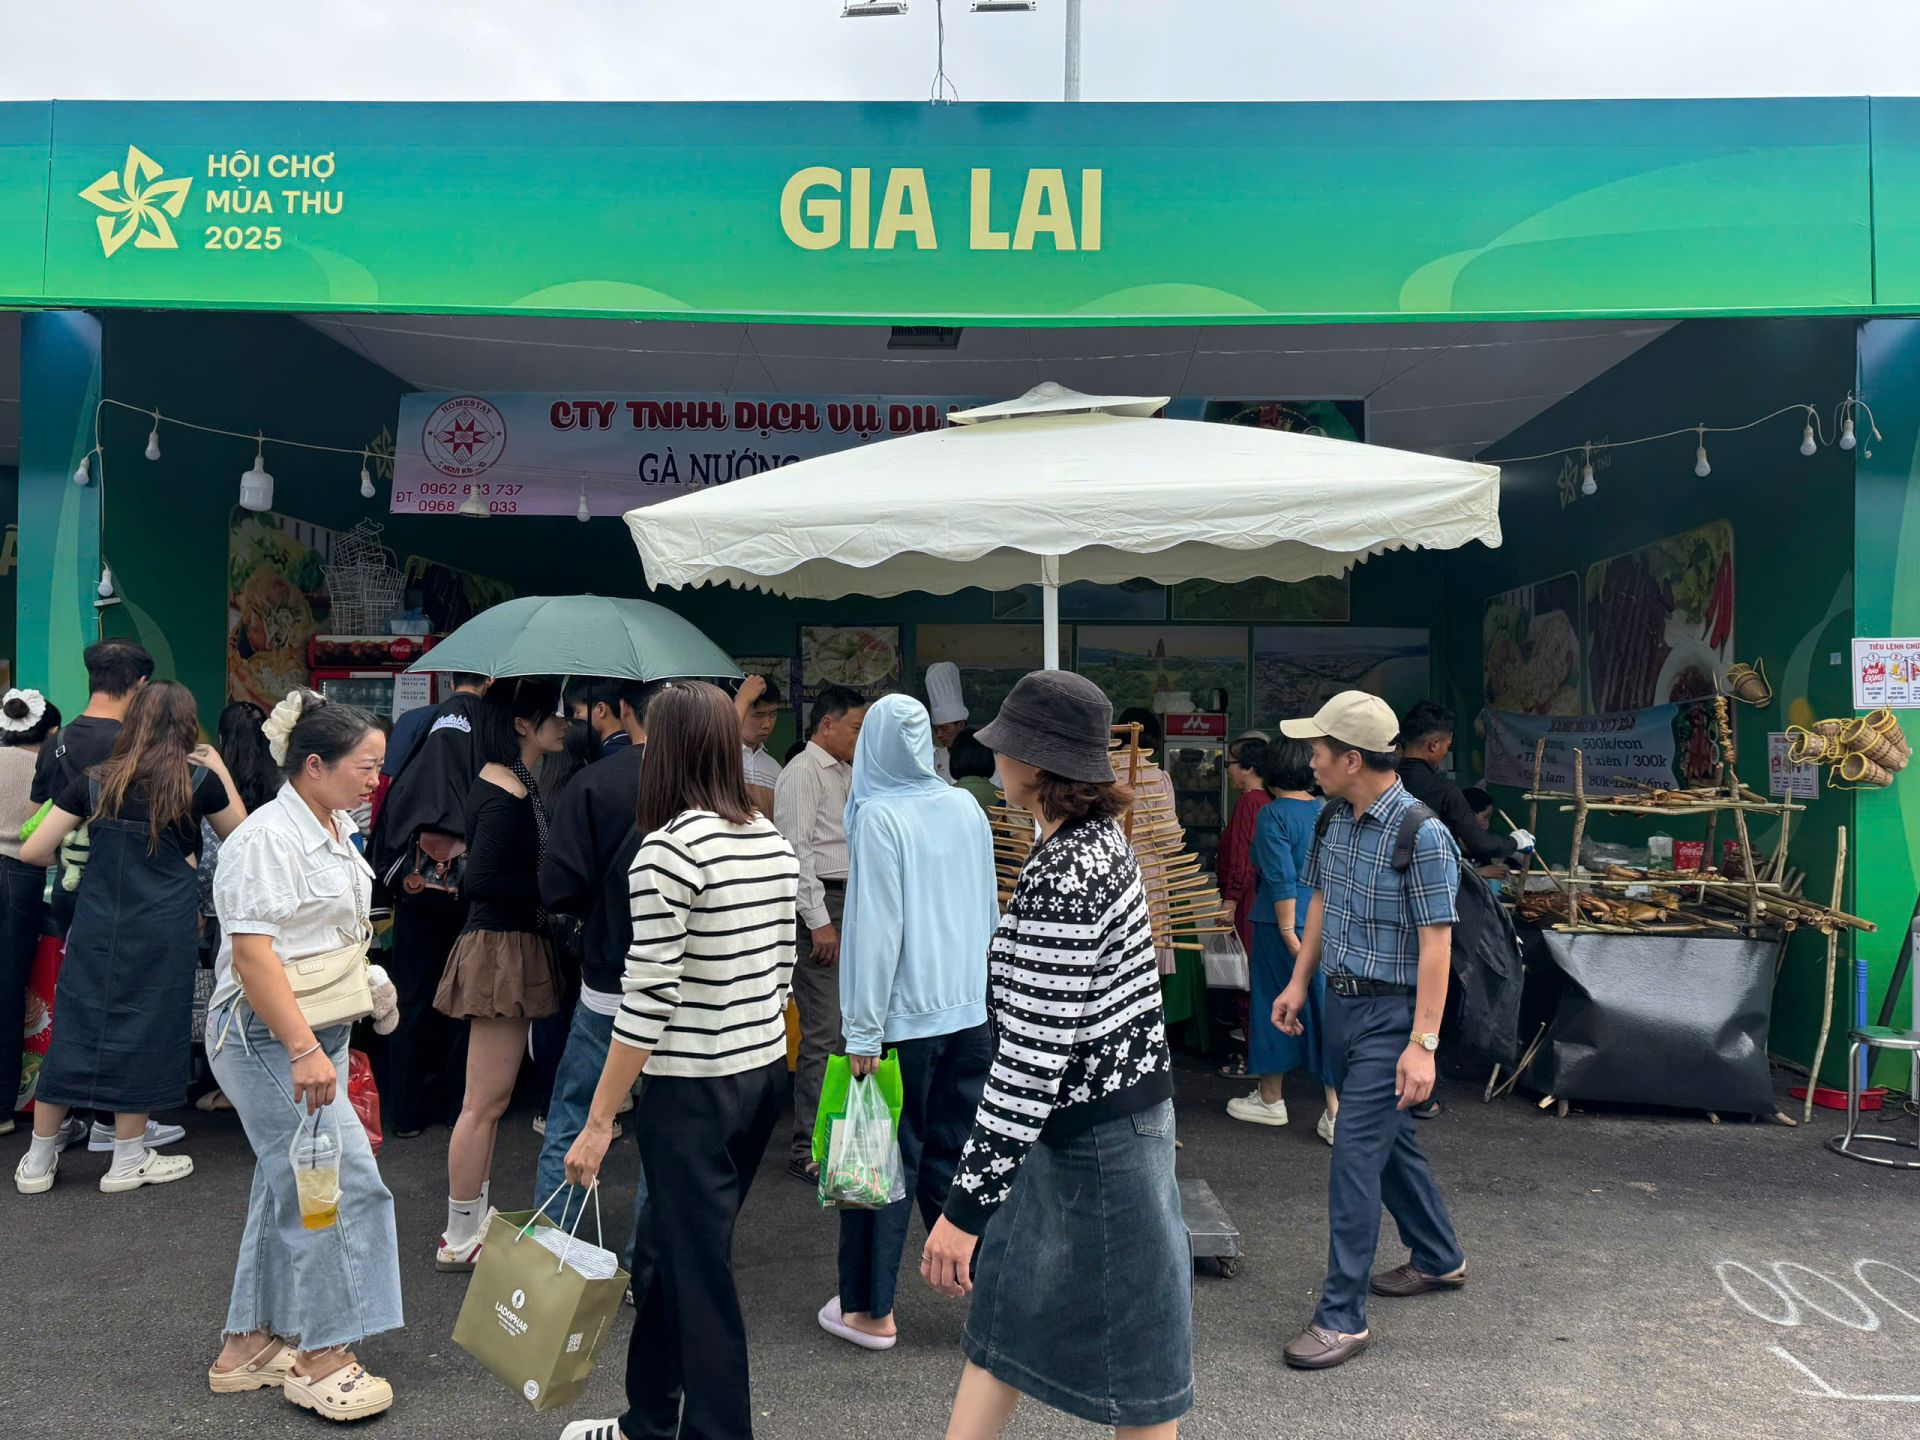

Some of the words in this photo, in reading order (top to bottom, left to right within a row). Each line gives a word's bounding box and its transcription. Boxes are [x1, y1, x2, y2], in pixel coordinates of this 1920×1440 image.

[207, 149, 260, 183] HỘI
[267, 151, 336, 184] CHỢ
[205, 185, 274, 214] MÙA
[281, 190, 344, 215] THU
[780, 166, 938, 250] GIA
[969, 168, 1102, 250] LAI
[204, 225, 283, 250] 2025
[441, 399, 494, 416] HOMESTAY
[550, 400, 618, 431] CTY
[625, 400, 728, 431] TNHH
[733, 401, 822, 439] DỊCH
[827, 403, 883, 440] VỤ
[888, 404, 943, 433] DU
[638, 446, 682, 486] GÀ
[395, 491, 417, 504] ĐT:
[419, 482, 457, 496] 0962
[495, 484, 523, 497] 737
[418, 499, 455, 513] 0968
[489, 501, 517, 513] 033
[1632, 754, 1667, 767] 300k
[495, 1300, 529, 1333] LADOPHAR
